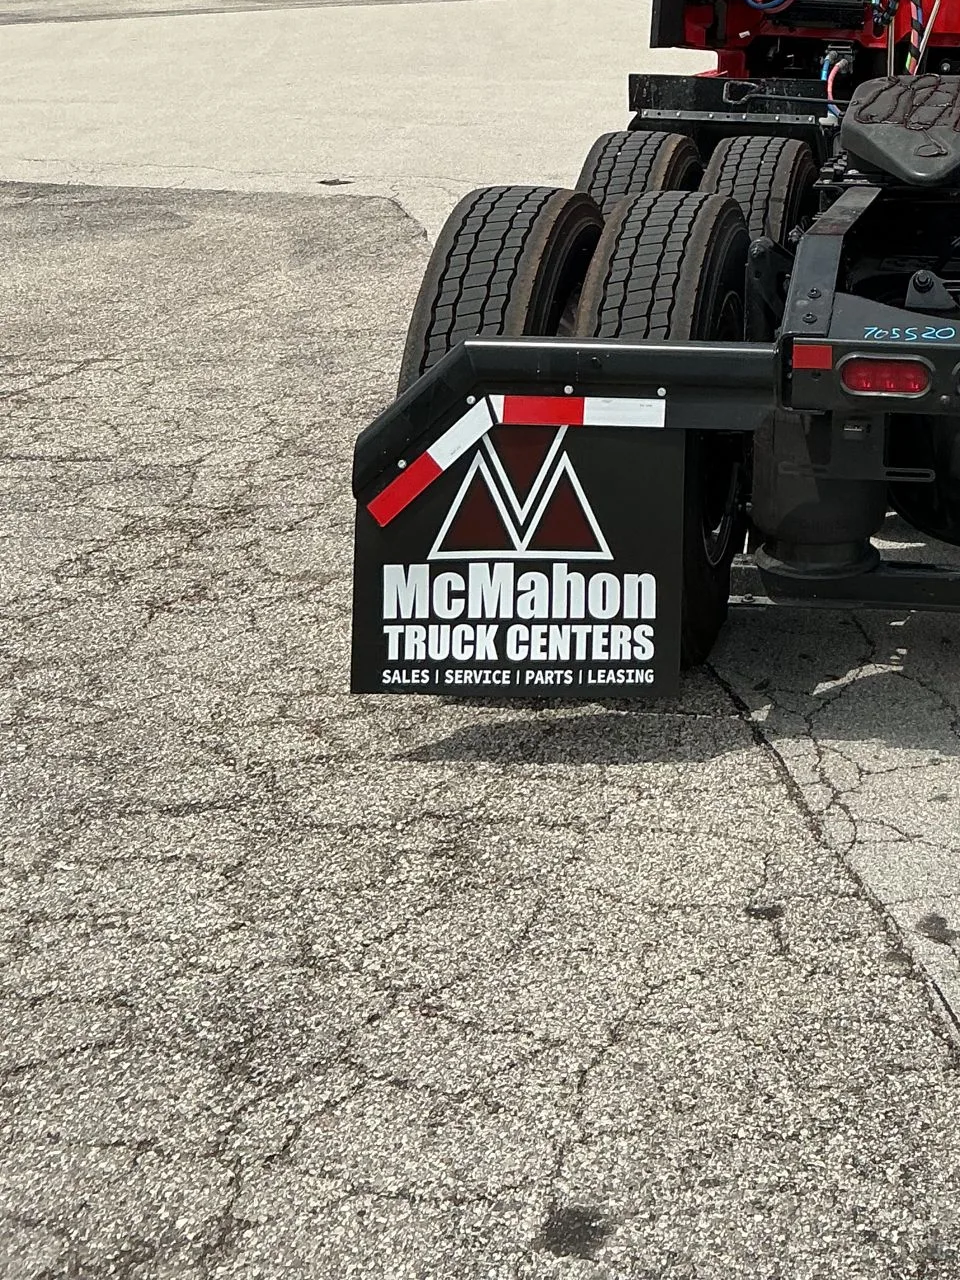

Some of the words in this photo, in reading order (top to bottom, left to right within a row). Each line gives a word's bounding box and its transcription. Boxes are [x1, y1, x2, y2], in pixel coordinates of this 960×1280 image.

[382, 562, 657, 620] McMahon
[383, 624, 499, 661] TRUCK
[506, 624, 655, 661] CENTERS
[382, 669, 430, 684] SALES
[444, 669, 511, 685] SERVICE
[525, 669, 573, 685] PARTS
[587, 669, 654, 684] LEASING
